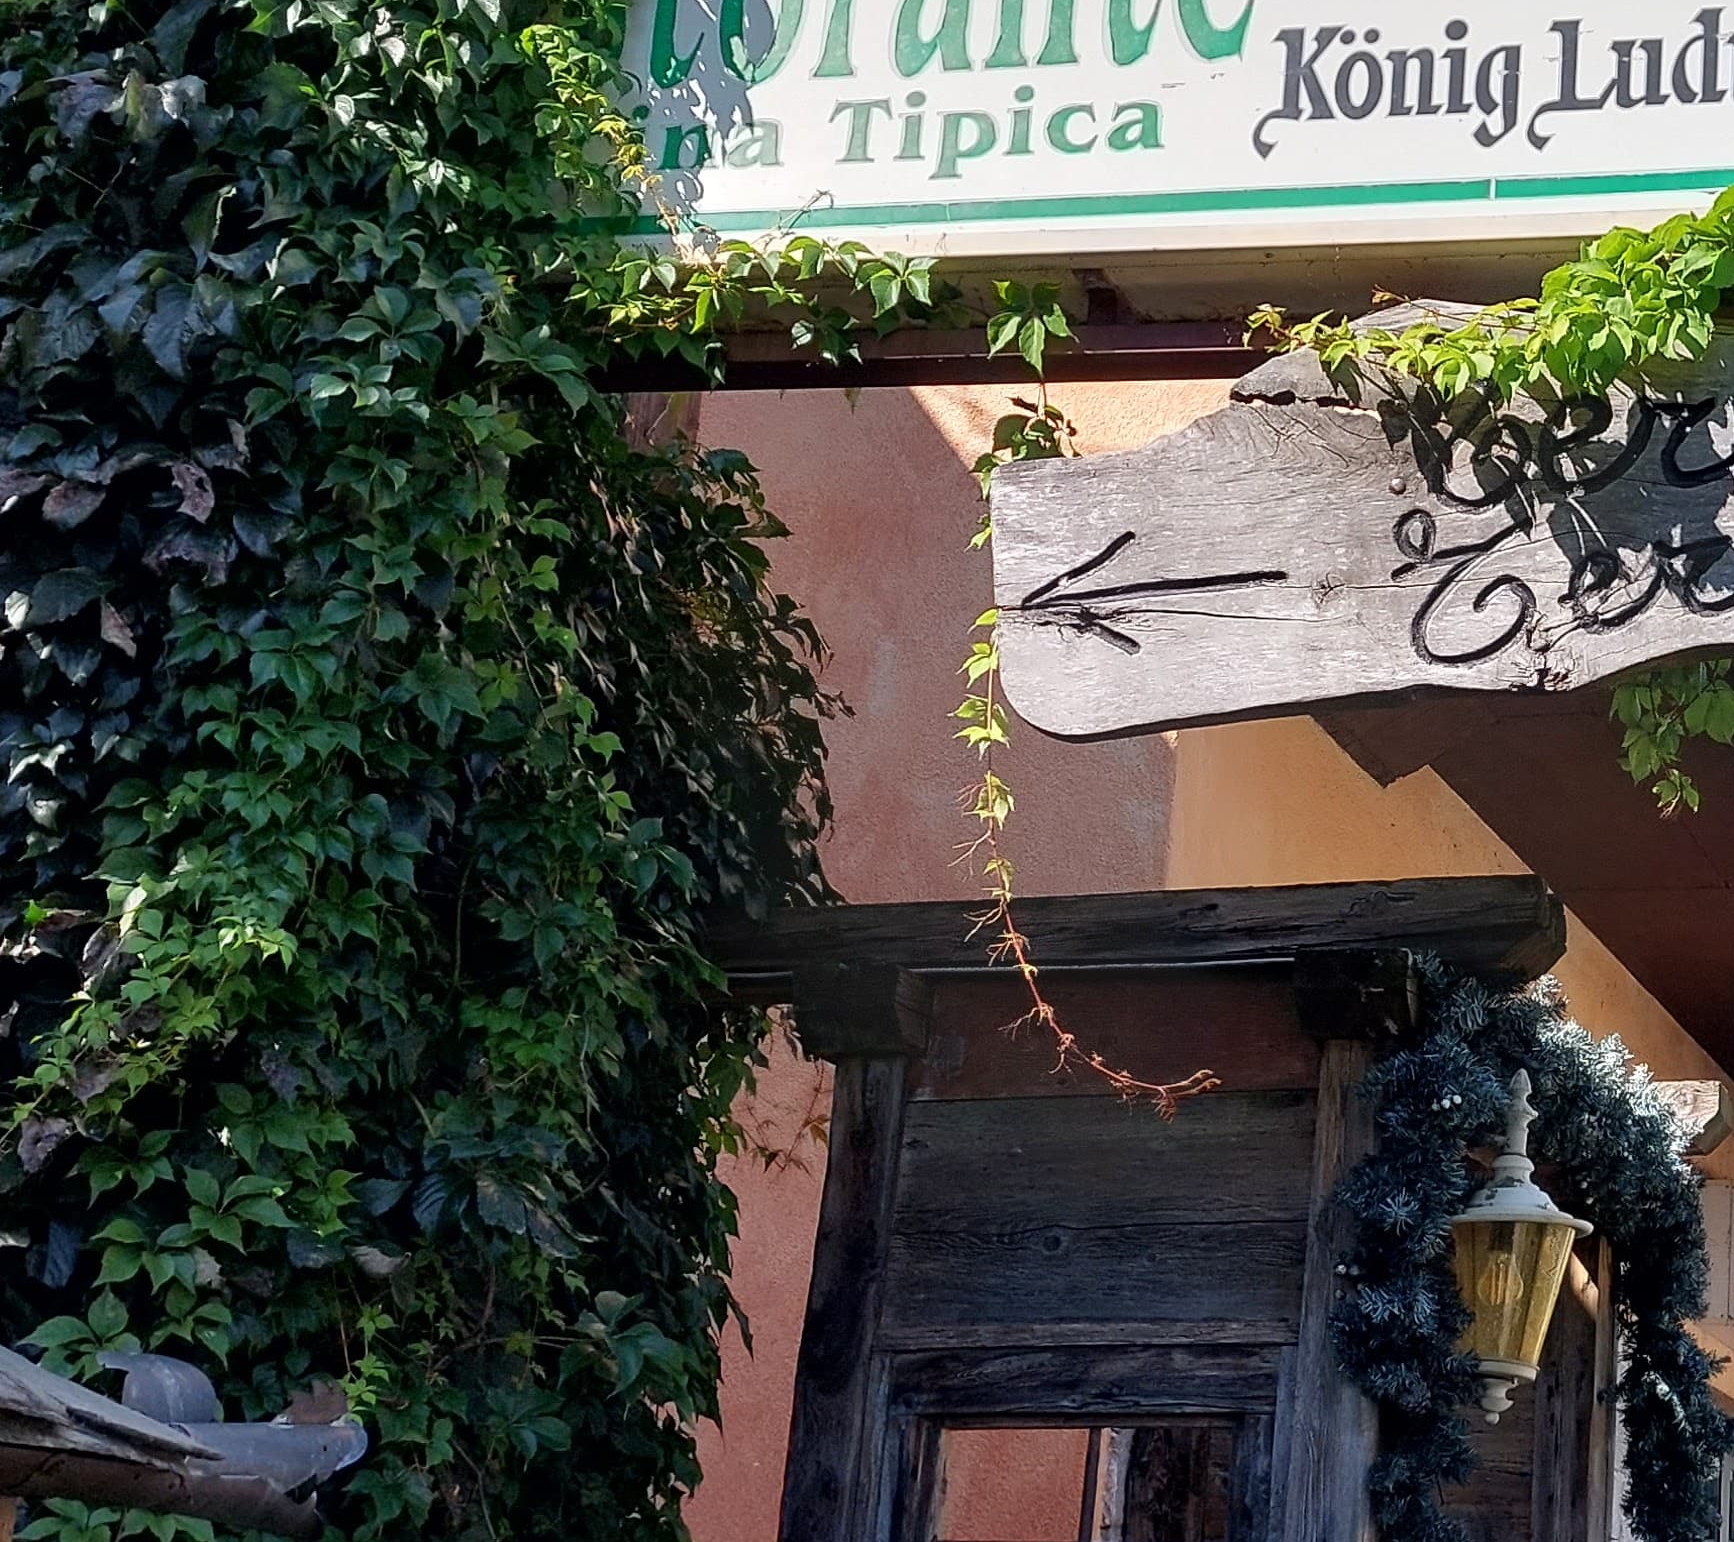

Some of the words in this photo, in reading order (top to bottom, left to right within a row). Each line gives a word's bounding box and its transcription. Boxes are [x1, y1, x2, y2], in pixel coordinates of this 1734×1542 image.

[634, 107, 785, 171] na
[829, 85, 1166, 180] Tipica
[1252, 18, 1521, 158] König
